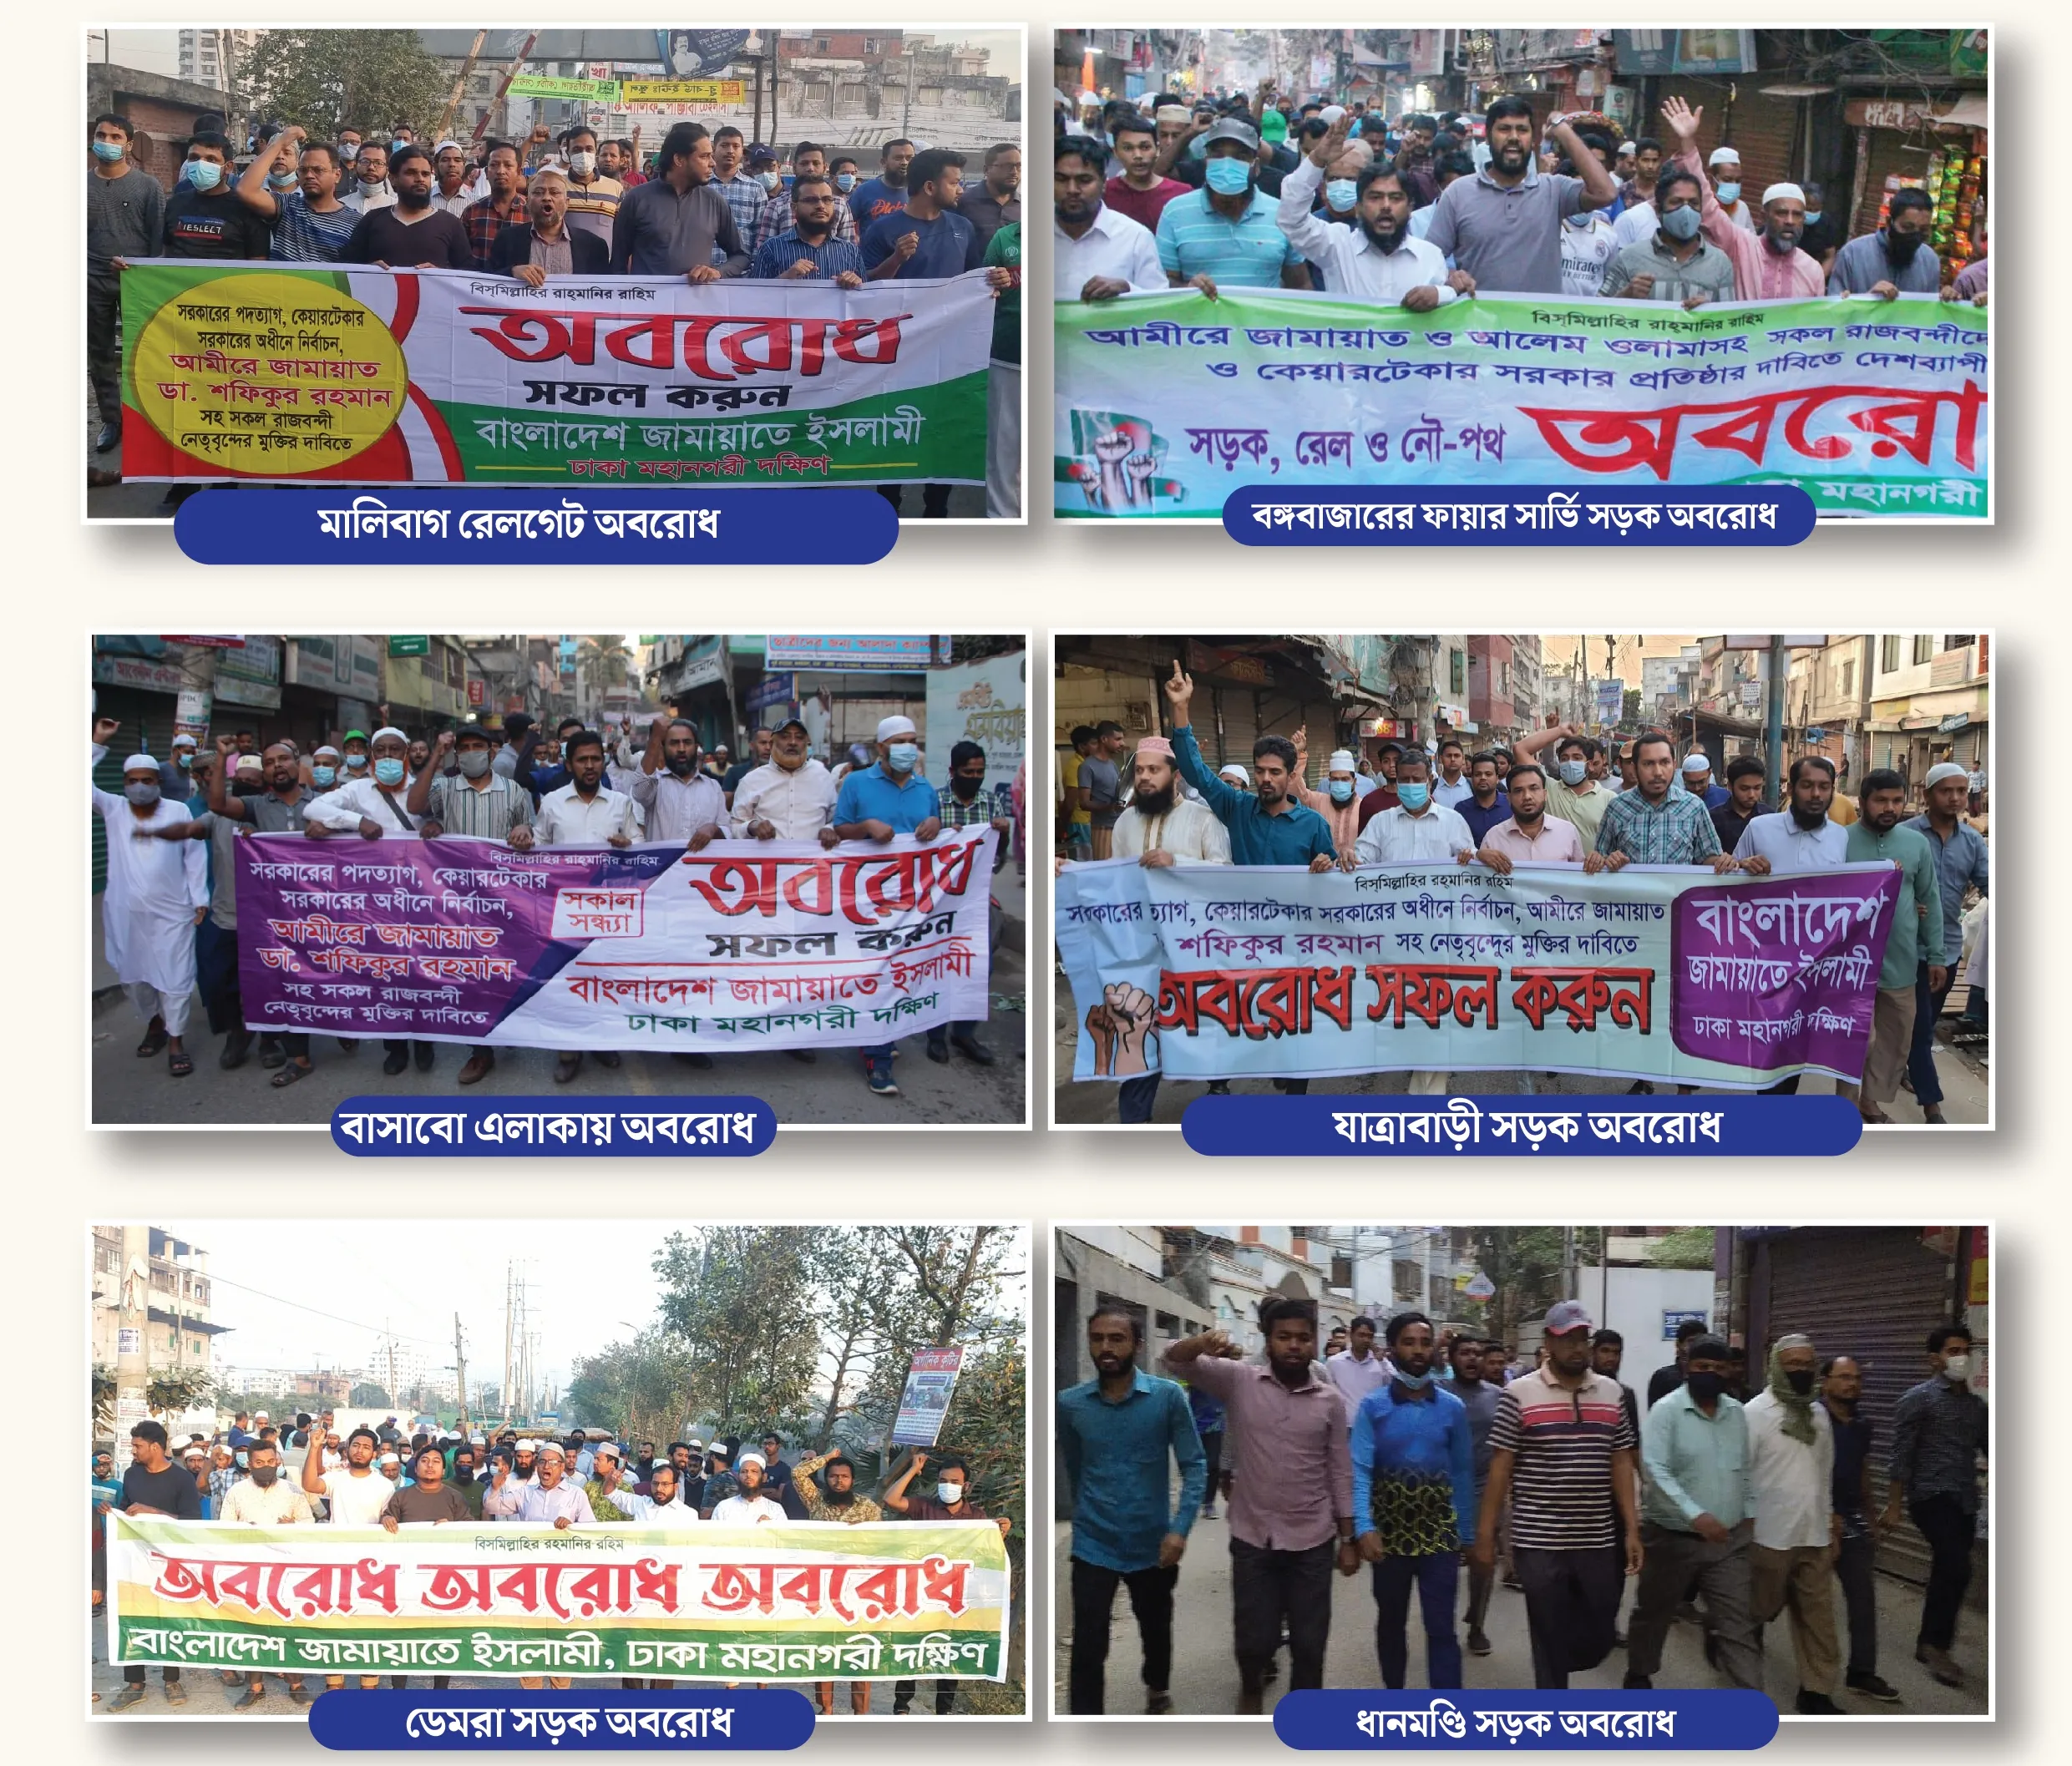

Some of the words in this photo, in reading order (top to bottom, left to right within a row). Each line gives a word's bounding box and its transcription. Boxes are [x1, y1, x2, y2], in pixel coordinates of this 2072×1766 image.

[618, 287, 656, 301] রাহিম
[177, 304, 231, 321] সরকারের
[236, 306, 286, 328] পদত্যাগ,
[291, 306, 365, 326] কেয়ারটেকার
[1728, 313, 1764, 328] রাহিম
[198, 331, 251, 351] সরকারের
[256, 328, 294, 352] অধীনে
[298, 330, 343, 357] নির্বাচন,
[458, 306, 914, 382] অবরোধ
[1084, 321, 1234, 347] আমীরে
[1244, 326, 1411, 349] জামায়াত
[1424, 331, 1452, 346] ও
[1465, 331, 1588, 354] আলেম
[1603, 334, 1750, 360] ওলামাসহ
[1767, 327, 1836, 346] সকল
[169, 349, 261, 375] আমীরে
[267, 358, 382, 380] জামায়াত
[1206, 361, 1239, 378] ও
[1256, 359, 1480, 383] কেয়ারটেকার
[1495, 364, 1617, 388] সরকার
[1629, 362, 1747, 391] প্রতিষ্ঠার
[1756, 352, 1845, 375] দাবিতে
[156, 382, 197, 402] ডা.
[207, 379, 300, 410] শফিকুর
[308, 387, 393, 410] রহমান
[523, 379, 648, 407] সফল
[665, 384, 792, 412] করুন
[200, 410, 225, 427] সহ
[230, 412, 266, 427] সকল
[273, 409, 333, 429] রাজবন্দী
[474, 417, 629, 454] বাংলাদেশ
[640, 421, 798, 453] জামায়াতে
[807, 405, 926, 447] ইসলামী
[180, 433, 253, 453] নেতৃবৃন্দের
[258, 432, 298, 453] মুক্তির
[303, 434, 352, 451] দাবিতে
[1183, 428, 1281, 475] সড়ক,
[1296, 430, 1355, 468] রেল
[1365, 430, 1388, 463] ও
[1400, 412, 1507, 464] নৌ-পথ
[567, 457, 631, 479] ঢাকা
[638, 455, 751, 481] মহানগরী
[757, 454, 833, 476] দক্ষিণ
[1815, 479, 1984, 507] মহানগরী
[250, 863, 335, 882] সরকারের
[342, 863, 423, 888] পদত্যাগ,
[433, 866, 550, 888] কেয়ারটেকার
[625, 855, 659, 866] রাহিম
[681, 838, 985, 925] অবরোধ
[1486, 873, 1513, 889] রহিম
[281, 890, 367, 911] সরকারের
[372, 888, 435, 913] অধীনে
[442, 891, 514, 919] নির্বাচন,
[562, 891, 638, 911] সকাল
[1205, 897, 1313, 923] কেয়ারটেকার
[1319, 902, 1396, 923] সরকারের
[1402, 893, 1455, 922] অধীনে
[1460, 893, 1522, 925] নির্বাচন,
[1527, 894, 1587, 922] আমীরে
[1591, 901, 1667, 922] জামায়াত
[267, 914, 371, 944] আমীরে
[373, 923, 503, 949] জামায়াত
[566, 913, 633, 934] সন্ধ্যা
[706, 932, 838, 958] সফল
[857, 909, 958, 951] করুন
[1690, 889, 1890, 949] বাংলাদেশ
[1175, 928, 1285, 963] শফিকুর
[1294, 934, 1385, 958] রহমান
[1396, 934, 1424, 954] সহ
[1521, 929, 1571, 959] মুক্তির
[1576, 929, 1640, 956] দাবিতে
[256, 947, 301, 972] ডা.
[307, 945, 414, 982] শফিকুর
[418, 955, 517, 982] রহমান
[565, 974, 718, 1005] বাংলাদেশ
[730, 973, 883, 1005] জামায়াতে
[890, 946, 978, 994] ইসলামী
[1686, 952, 1792, 993] জামায়াতে
[1794, 944, 1873, 992] ইসলামী
[283, 982, 315, 1000] সহ
[320, 984, 372, 999] সকল
[381, 986, 463, 1004] রাজবন্দী
[1154, 965, 1356, 1040] অবরোধ
[1365, 964, 1502, 1031] সফল
[1511, 966, 1656, 1035] করুন
[264, 1001, 353, 1022] নেতৃবৃন্দের
[362, 1004, 414, 1023] মুক্তির
[420, 1007, 489, 1025] দাবিতে
[624, 1012, 702, 1034] ঢাকা
[712, 1005, 861, 1035] মহানগরী
[869, 991, 940, 1025] দক্ষিণ
[1692, 1015, 1732, 1040] ঢাকা
[1736, 1009, 1805, 1045] মহানগরী
[544, 1536, 591, 1551] রহমানির
[596, 1536, 624, 1551] রহিম
[150, 1558, 402, 1618] অবরোধ
[416, 1558, 682, 1620] অবরোধ
[698, 1557, 970, 1622] অবরোধ
[129, 1628, 286, 1661] বাংলাদেশ
[295, 1637, 463, 1667] জামায়াতে
[471, 1631, 615, 1671] ইসলামী,
[626, 1642, 710, 1669] ঢাকা
[721, 1634, 884, 1673] মহানগরী
[893, 1632, 989, 1669] দক্ষিণ
